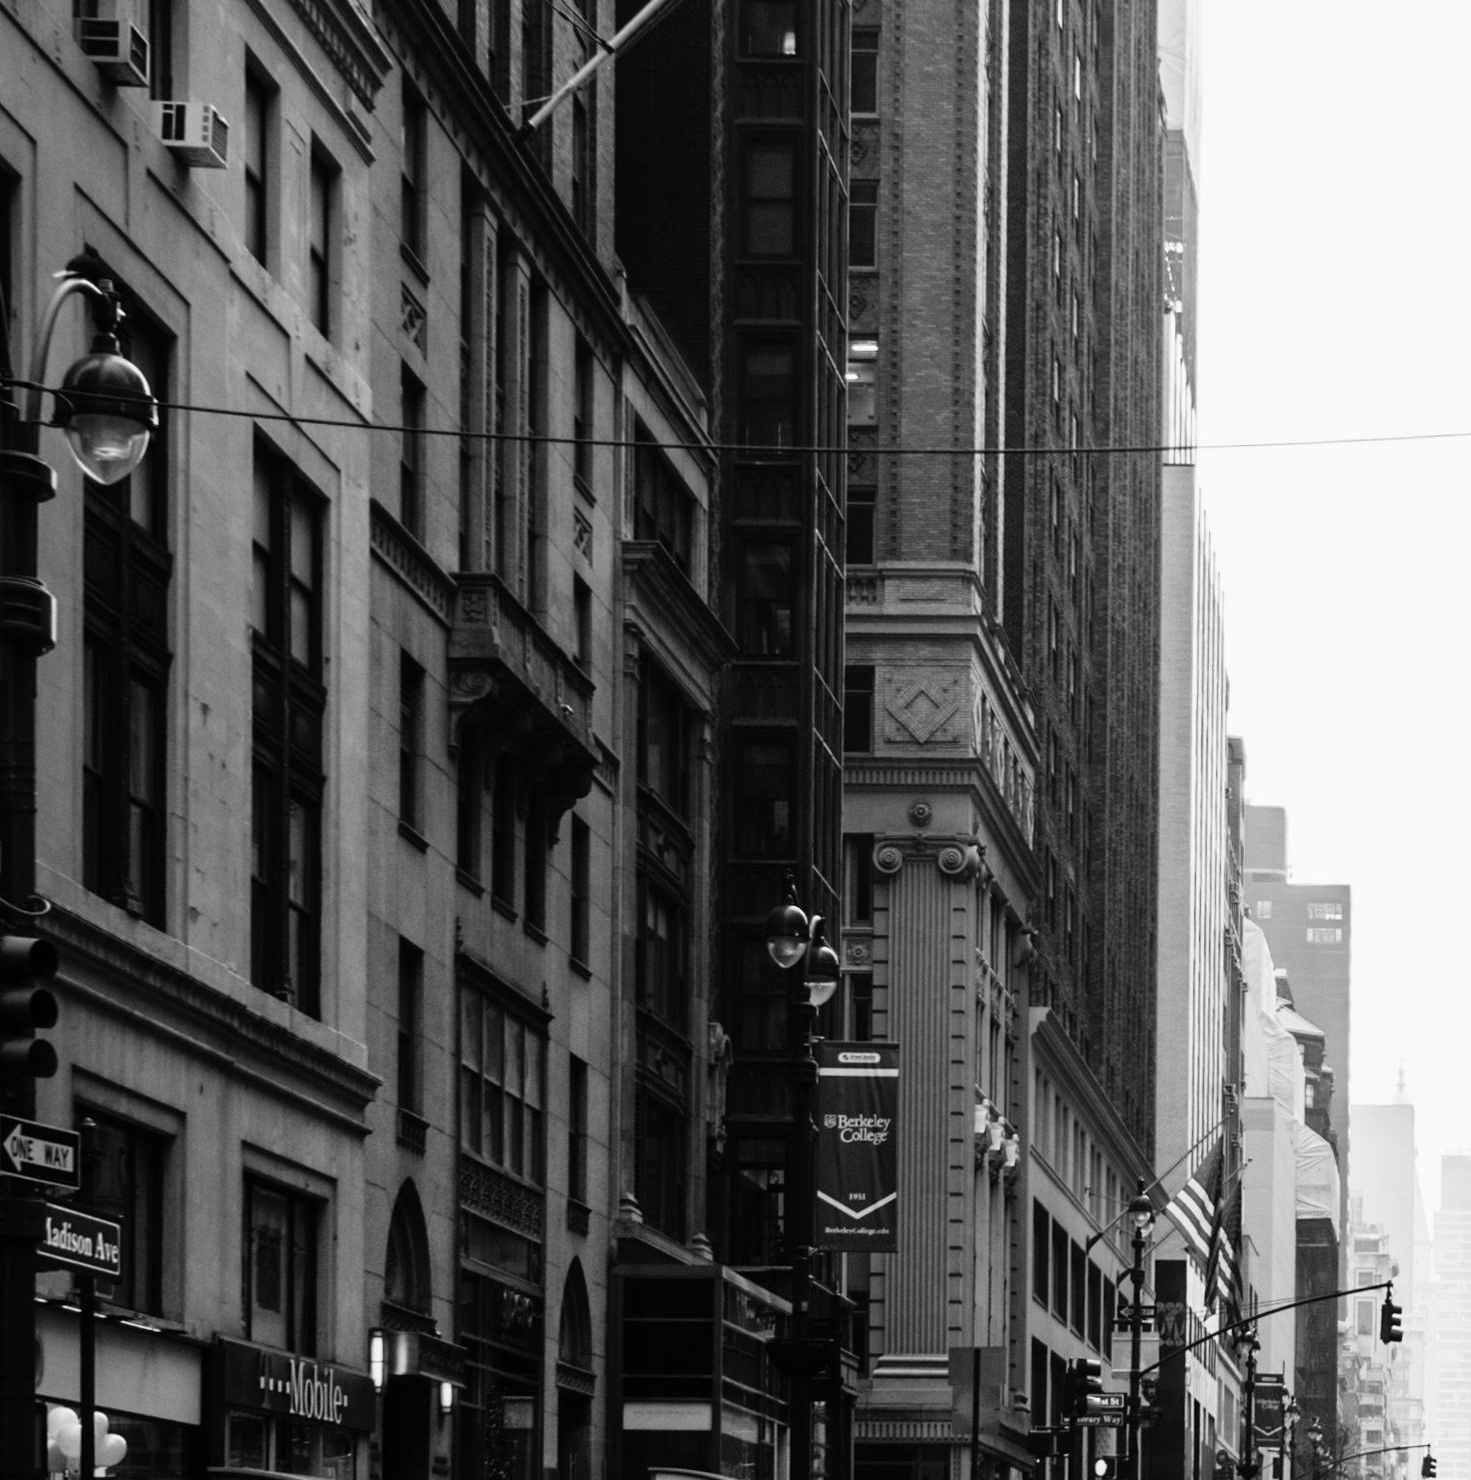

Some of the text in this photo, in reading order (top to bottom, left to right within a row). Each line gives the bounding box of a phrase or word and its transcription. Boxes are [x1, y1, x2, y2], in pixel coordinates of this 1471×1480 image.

[838, 1113, 891, 1132] Berkeley
[840, 1127, 889, 1146] College
[10, 1136, 70, 1169] ONE WAY
[94, 1232, 119, 1264] Ave
[1103, 1414, 1121, 1425] Way
